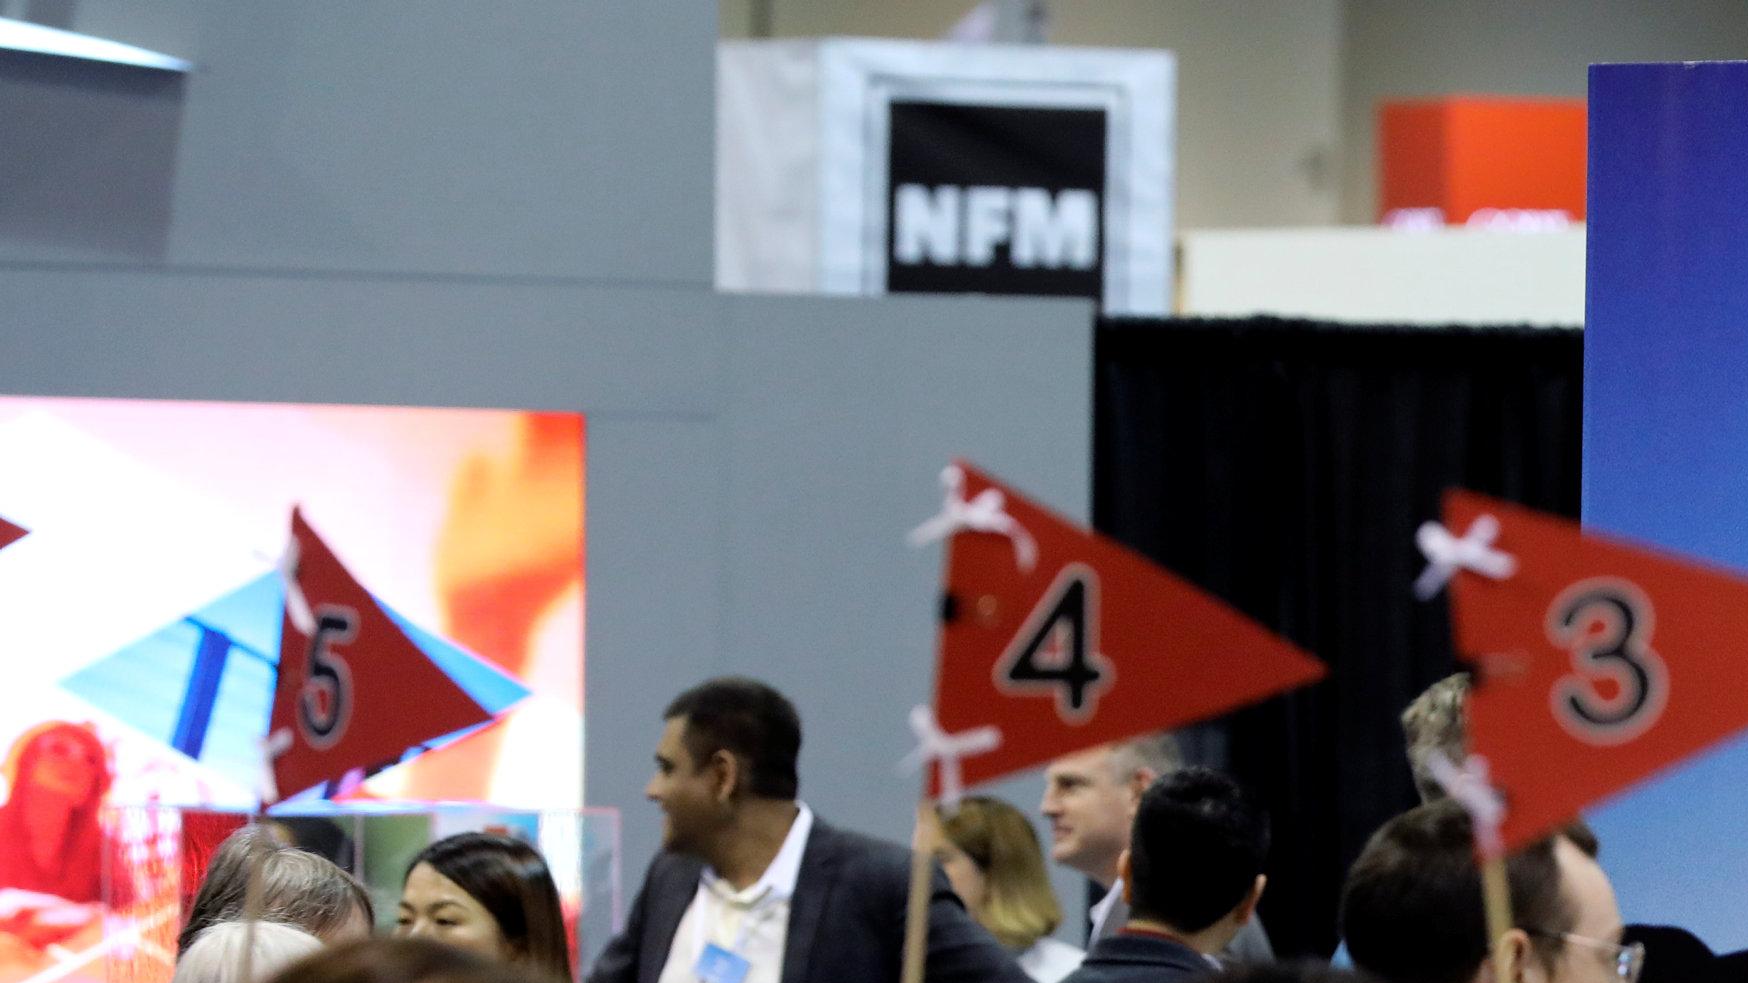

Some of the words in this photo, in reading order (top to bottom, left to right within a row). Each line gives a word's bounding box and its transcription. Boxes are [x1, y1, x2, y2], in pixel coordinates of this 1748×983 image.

[894, 183, 1098, 270] NFM
[300, 604, 358, 746] 5
[998, 564, 1111, 720] 4
[1550, 579, 1667, 743] 3
